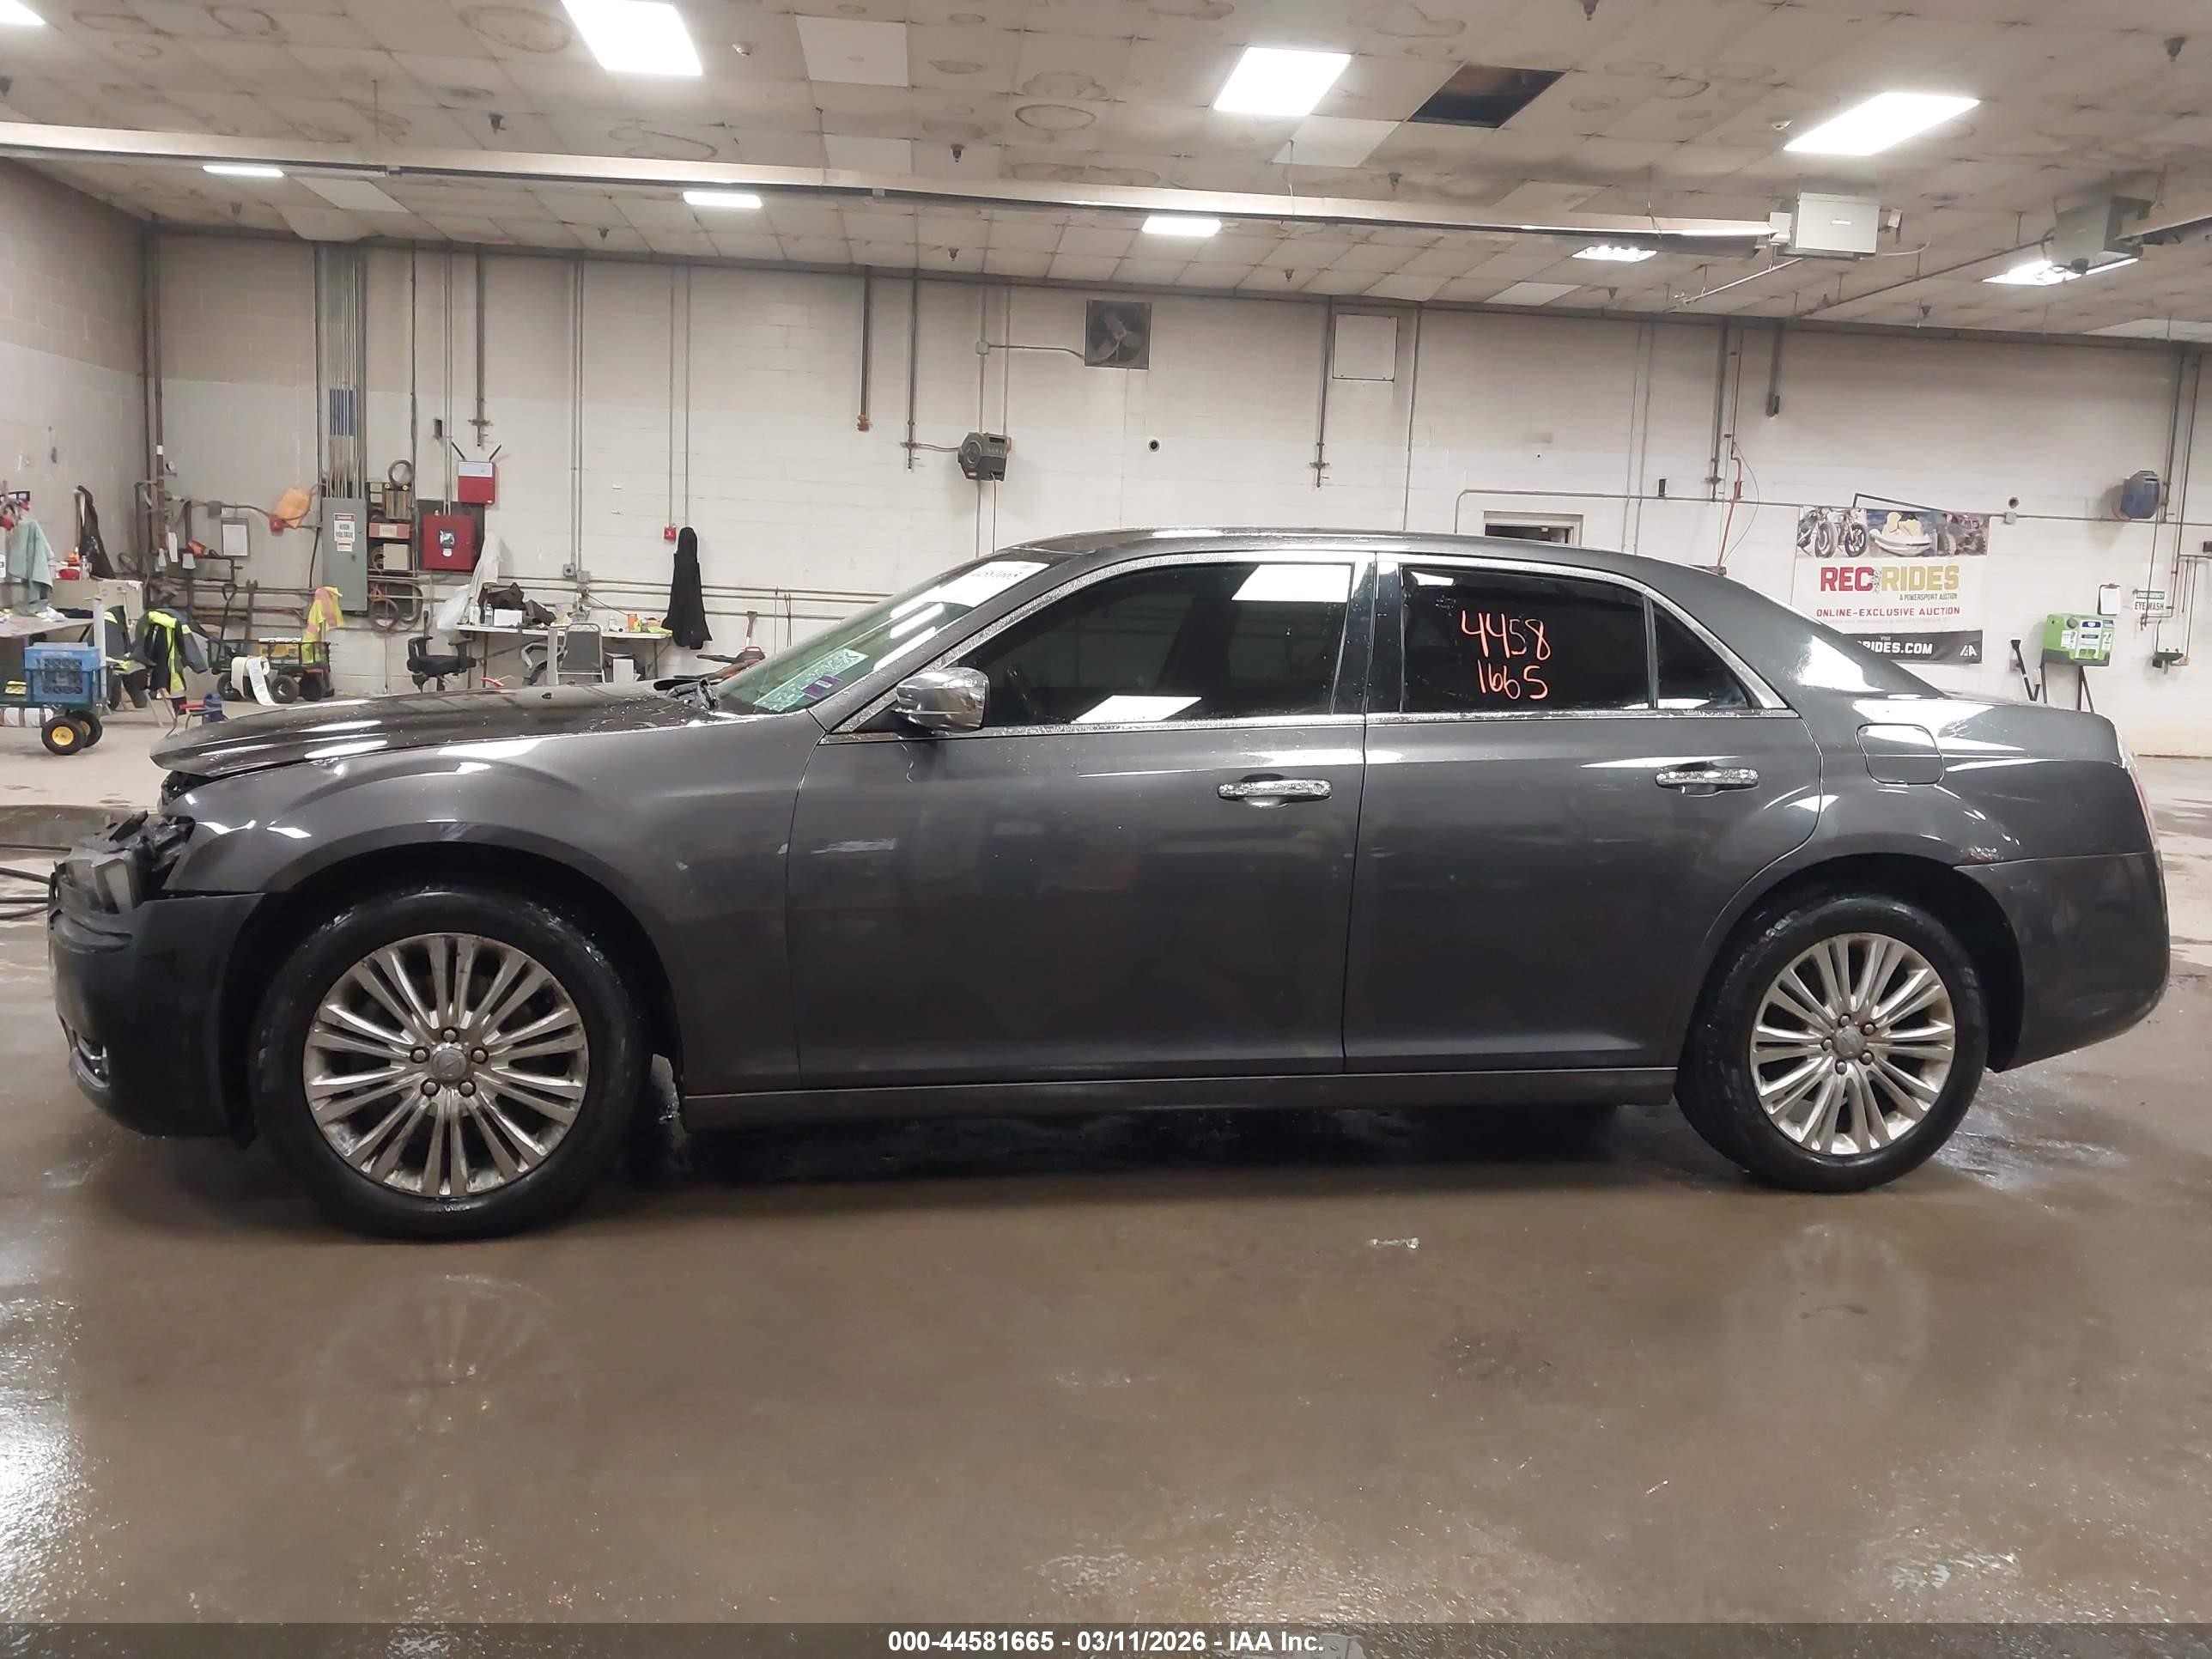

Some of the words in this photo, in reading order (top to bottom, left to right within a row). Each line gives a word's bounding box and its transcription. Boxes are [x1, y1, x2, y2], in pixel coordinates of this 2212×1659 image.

[1820, 567, 1874, 592] REC
[1881, 565, 1960, 591] RIDES
[1816, 608, 1916, 617] ONLINE-EXCLUSIVE
[1918, 606, 1960, 616] AUCTION
[2135, 602, 2146, 611] EYE
[1462, 610, 1551, 660] 4458
[1477, 659, 1548, 700] 1665
